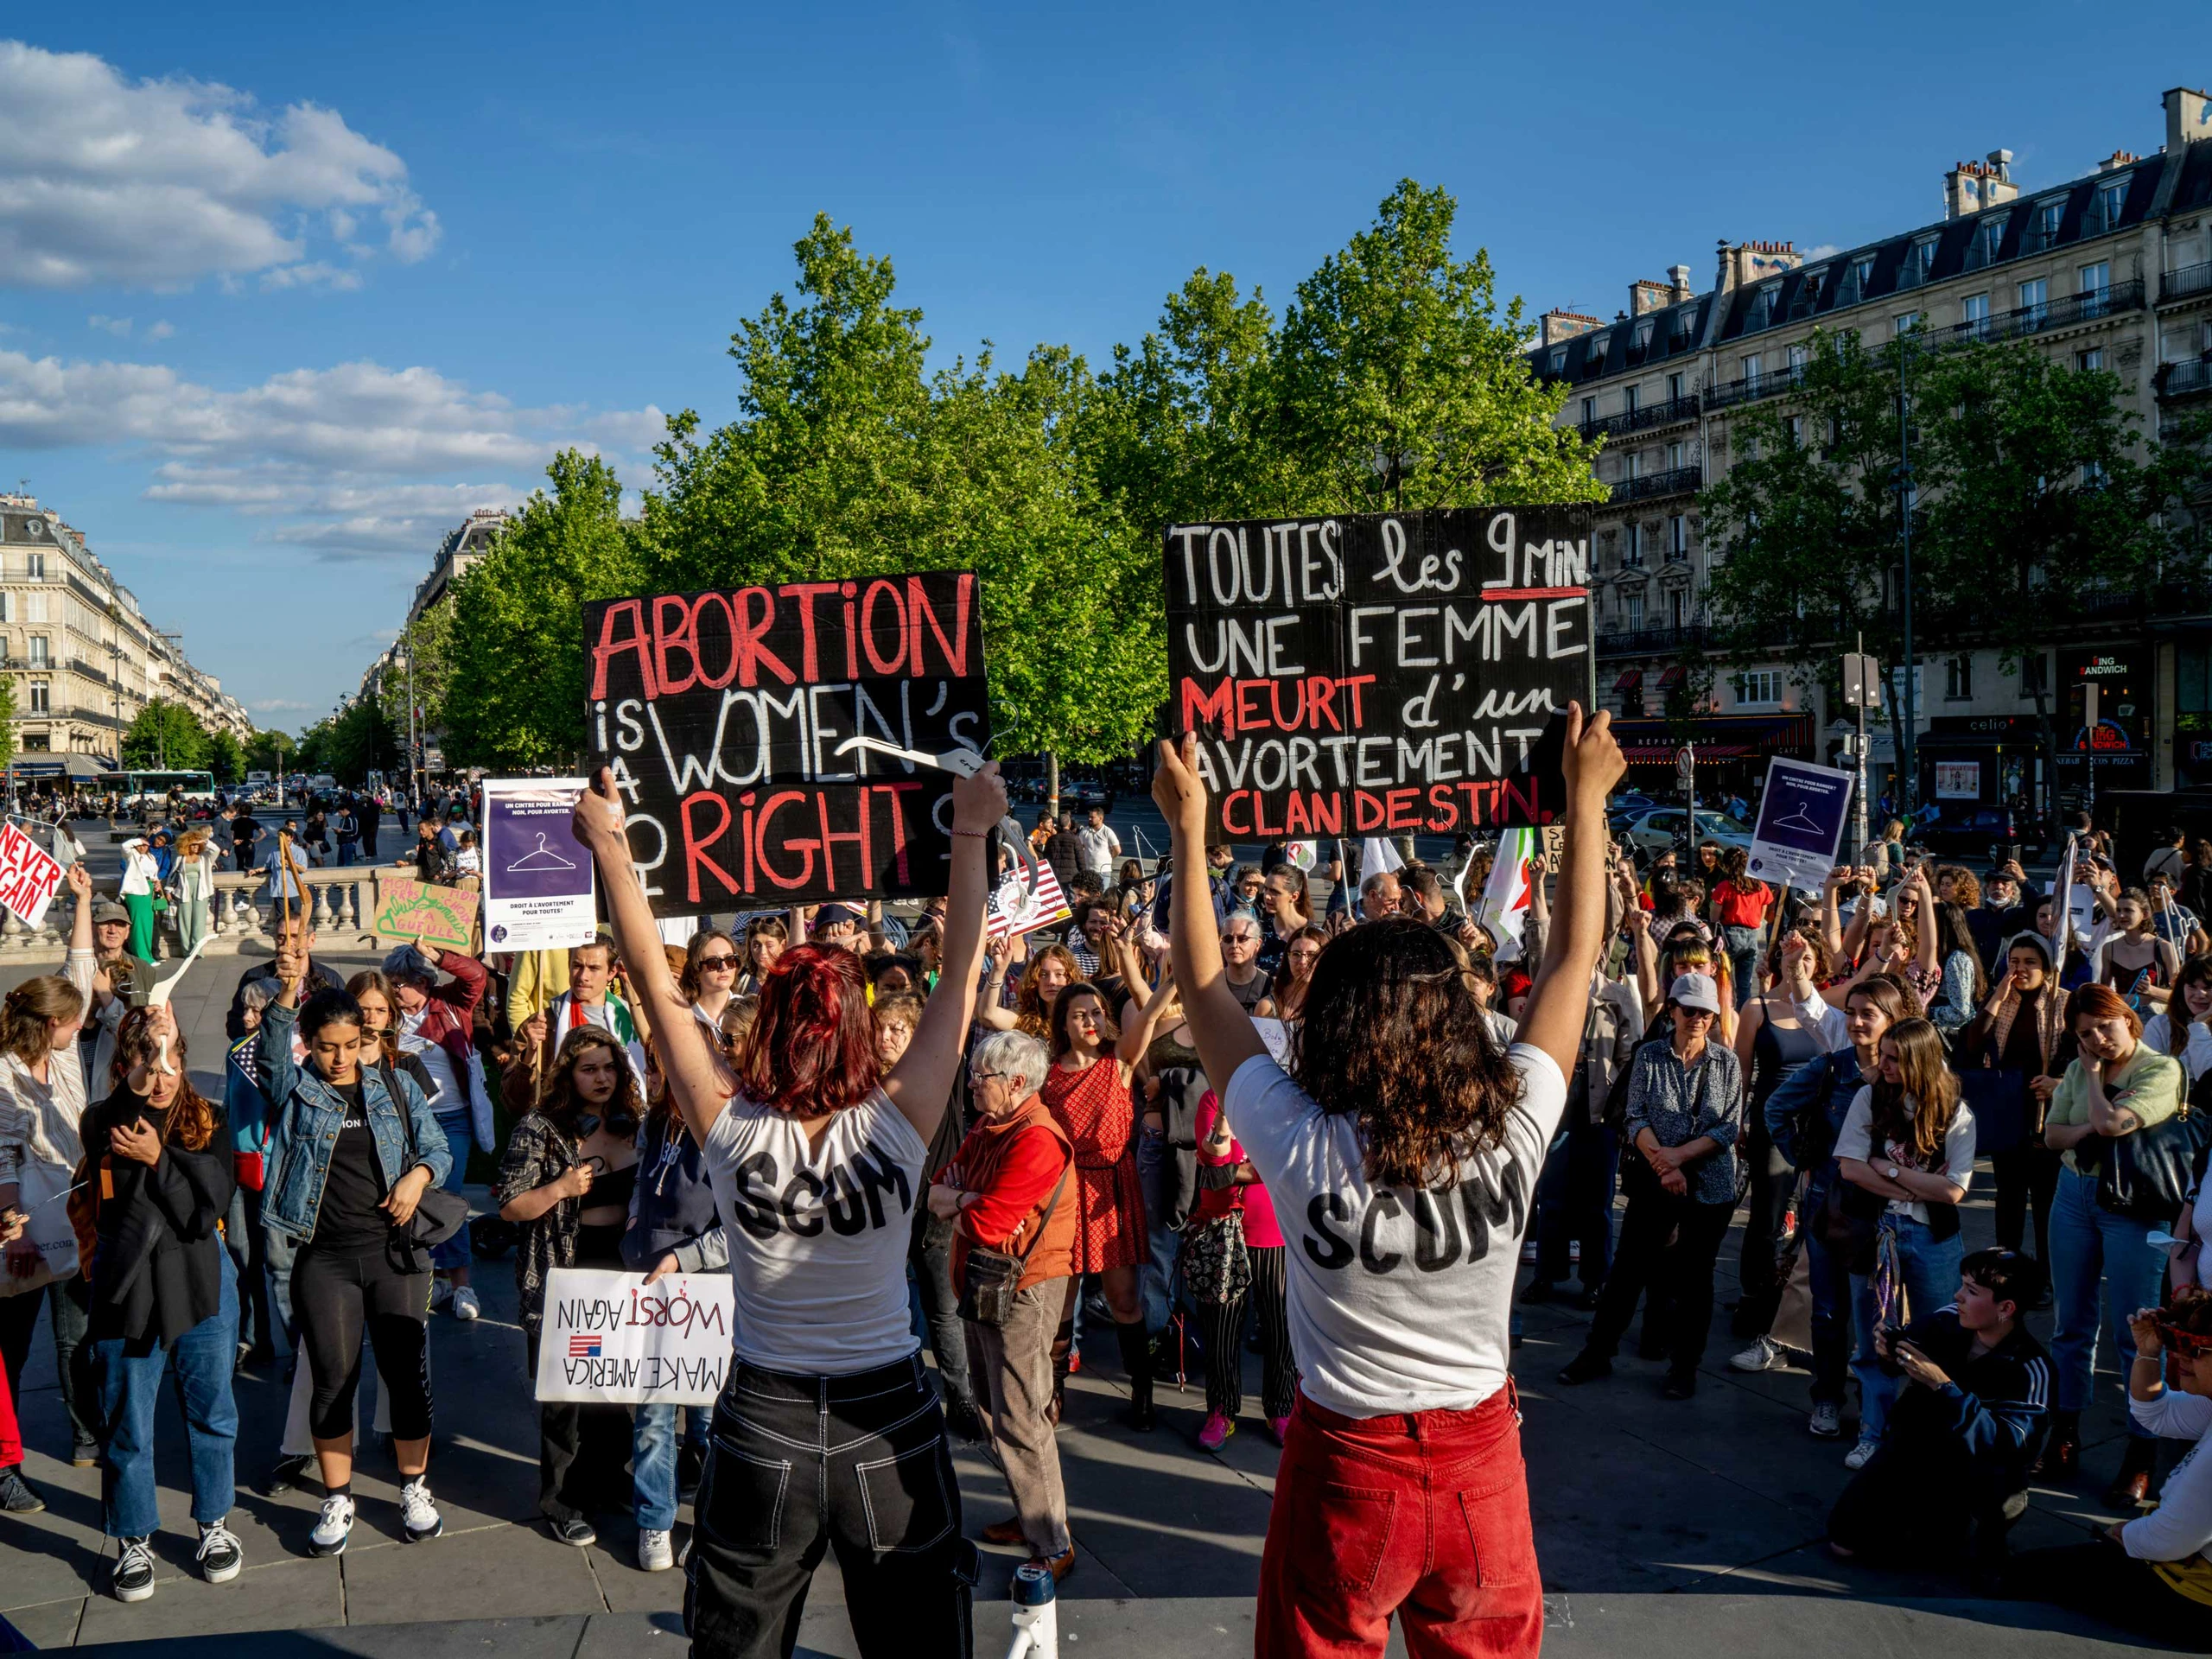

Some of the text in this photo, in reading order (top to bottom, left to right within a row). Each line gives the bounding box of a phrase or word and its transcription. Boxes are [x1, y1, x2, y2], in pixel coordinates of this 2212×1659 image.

[1168, 520, 1344, 607] TOUTES
[1372, 518, 1464, 593] les
[1481, 513, 1516, 588] 9
[1185, 597, 1588, 677] UNE FEMME
[2080, 665, 2127, 675] SANDWICH
[2093, 657, 2114, 666] KING
[1180, 674, 1376, 742] MEURT
[1970, 718, 2006, 730] celio
[1198, 727, 1545, 793] AVORTEMENT
[2078, 741, 2126, 750] SNDWICH
[0, 823, 60, 898] NEVER
[0, 857, 42, 920] GAIN
[381, 887, 419, 901] CORPS
[382, 877, 413, 890] MON
[449, 888, 477, 903] MON
[397, 918, 454, 939] GUEULE
[443, 898, 473, 925] CHOIX
[735, 1141, 912, 1240] SCUM
[1303, 1155, 1525, 1275] SCUM
[625, 1294, 725, 1339] WORST
[643, 1357, 722, 1392] MAKE
